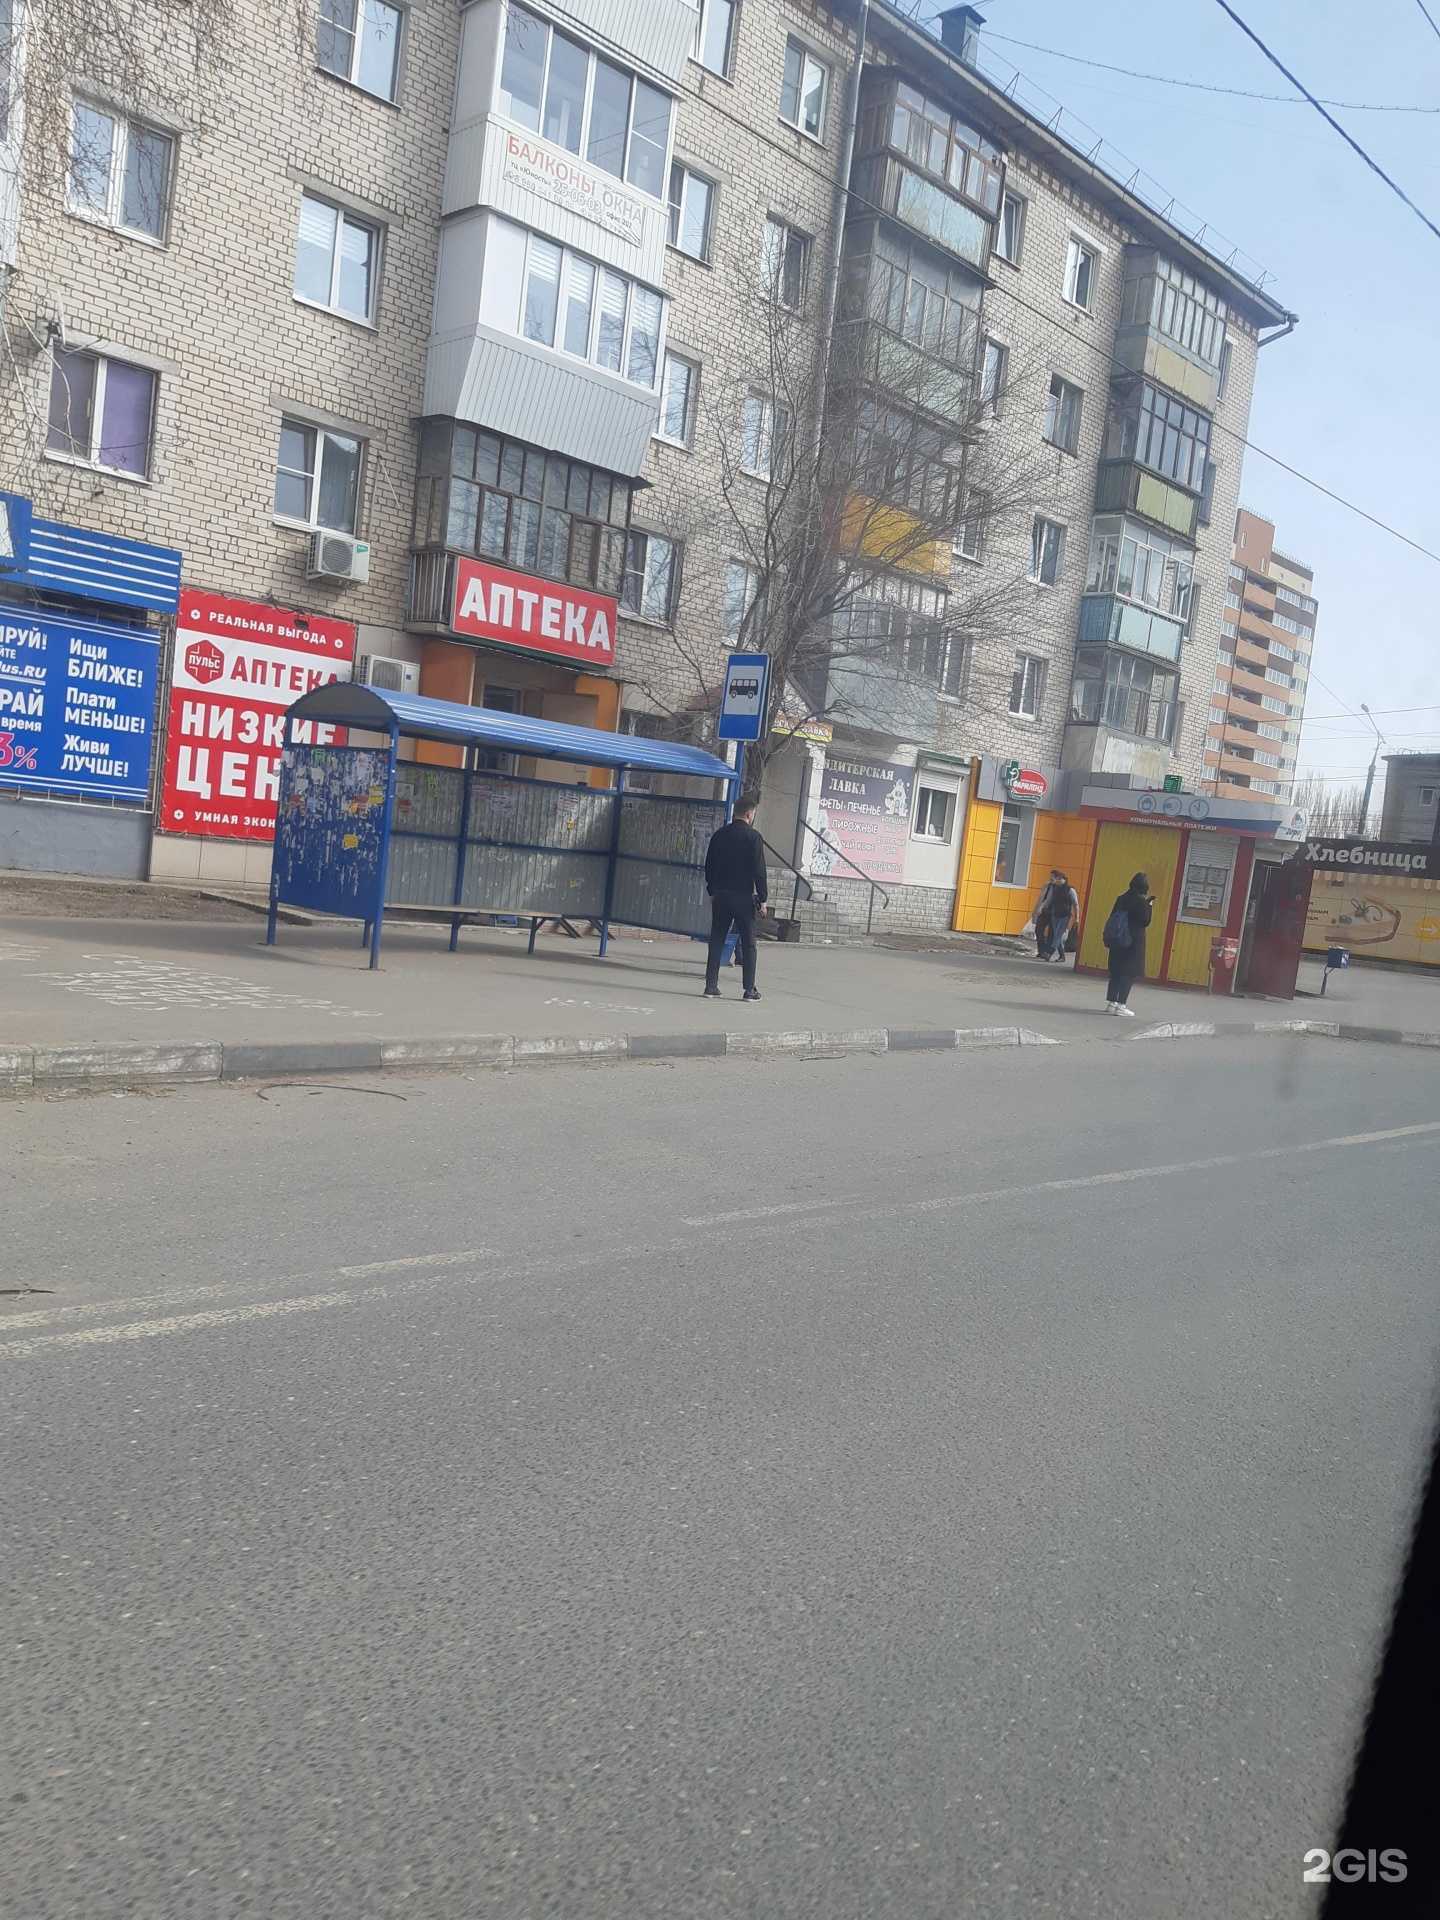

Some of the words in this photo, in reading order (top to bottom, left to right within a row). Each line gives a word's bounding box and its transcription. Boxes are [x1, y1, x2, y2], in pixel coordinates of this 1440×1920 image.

[508, 135, 596, 197] БАЛКОНЫ
[602, 190, 643, 225] ОКНА
[459, 577, 611, 650] АПТЕКА
[209, 611, 274, 634] РЕАЛЬНАЯ
[278, 626, 327, 645] ВЫГОДА
[69, 637, 108, 660] Ищи
[67, 658, 143, 688] БЛИЖЕ!
[188, 654, 221, 669] ПУЛЬС
[66, 686, 116, 710] Плати
[1, 717, 42, 732] время
[64, 707, 145, 734] МЕНЬШЕ!
[181, 700, 337, 748] НИЗКИЕ
[63, 734, 110, 756] Живи
[60, 754, 129, 778] ЛУЧШЕ!
[176, 745, 281, 801] ЦЕН
[824, 759, 894, 780] НДИТЕРСКАЯ
[829, 778, 866, 795] ЛАВКА
[820, 798, 843, 810] ФЕТЫ
[847, 801, 881, 816] ПЕЧЕНЬЕ
[194, 811, 238, 825] УМНАЯ
[243, 816, 276, 829] ЭКОН
[832, 819, 879, 834] ПИРОЖНЫЕ
[1305, 843, 1427, 872] Хлебница
